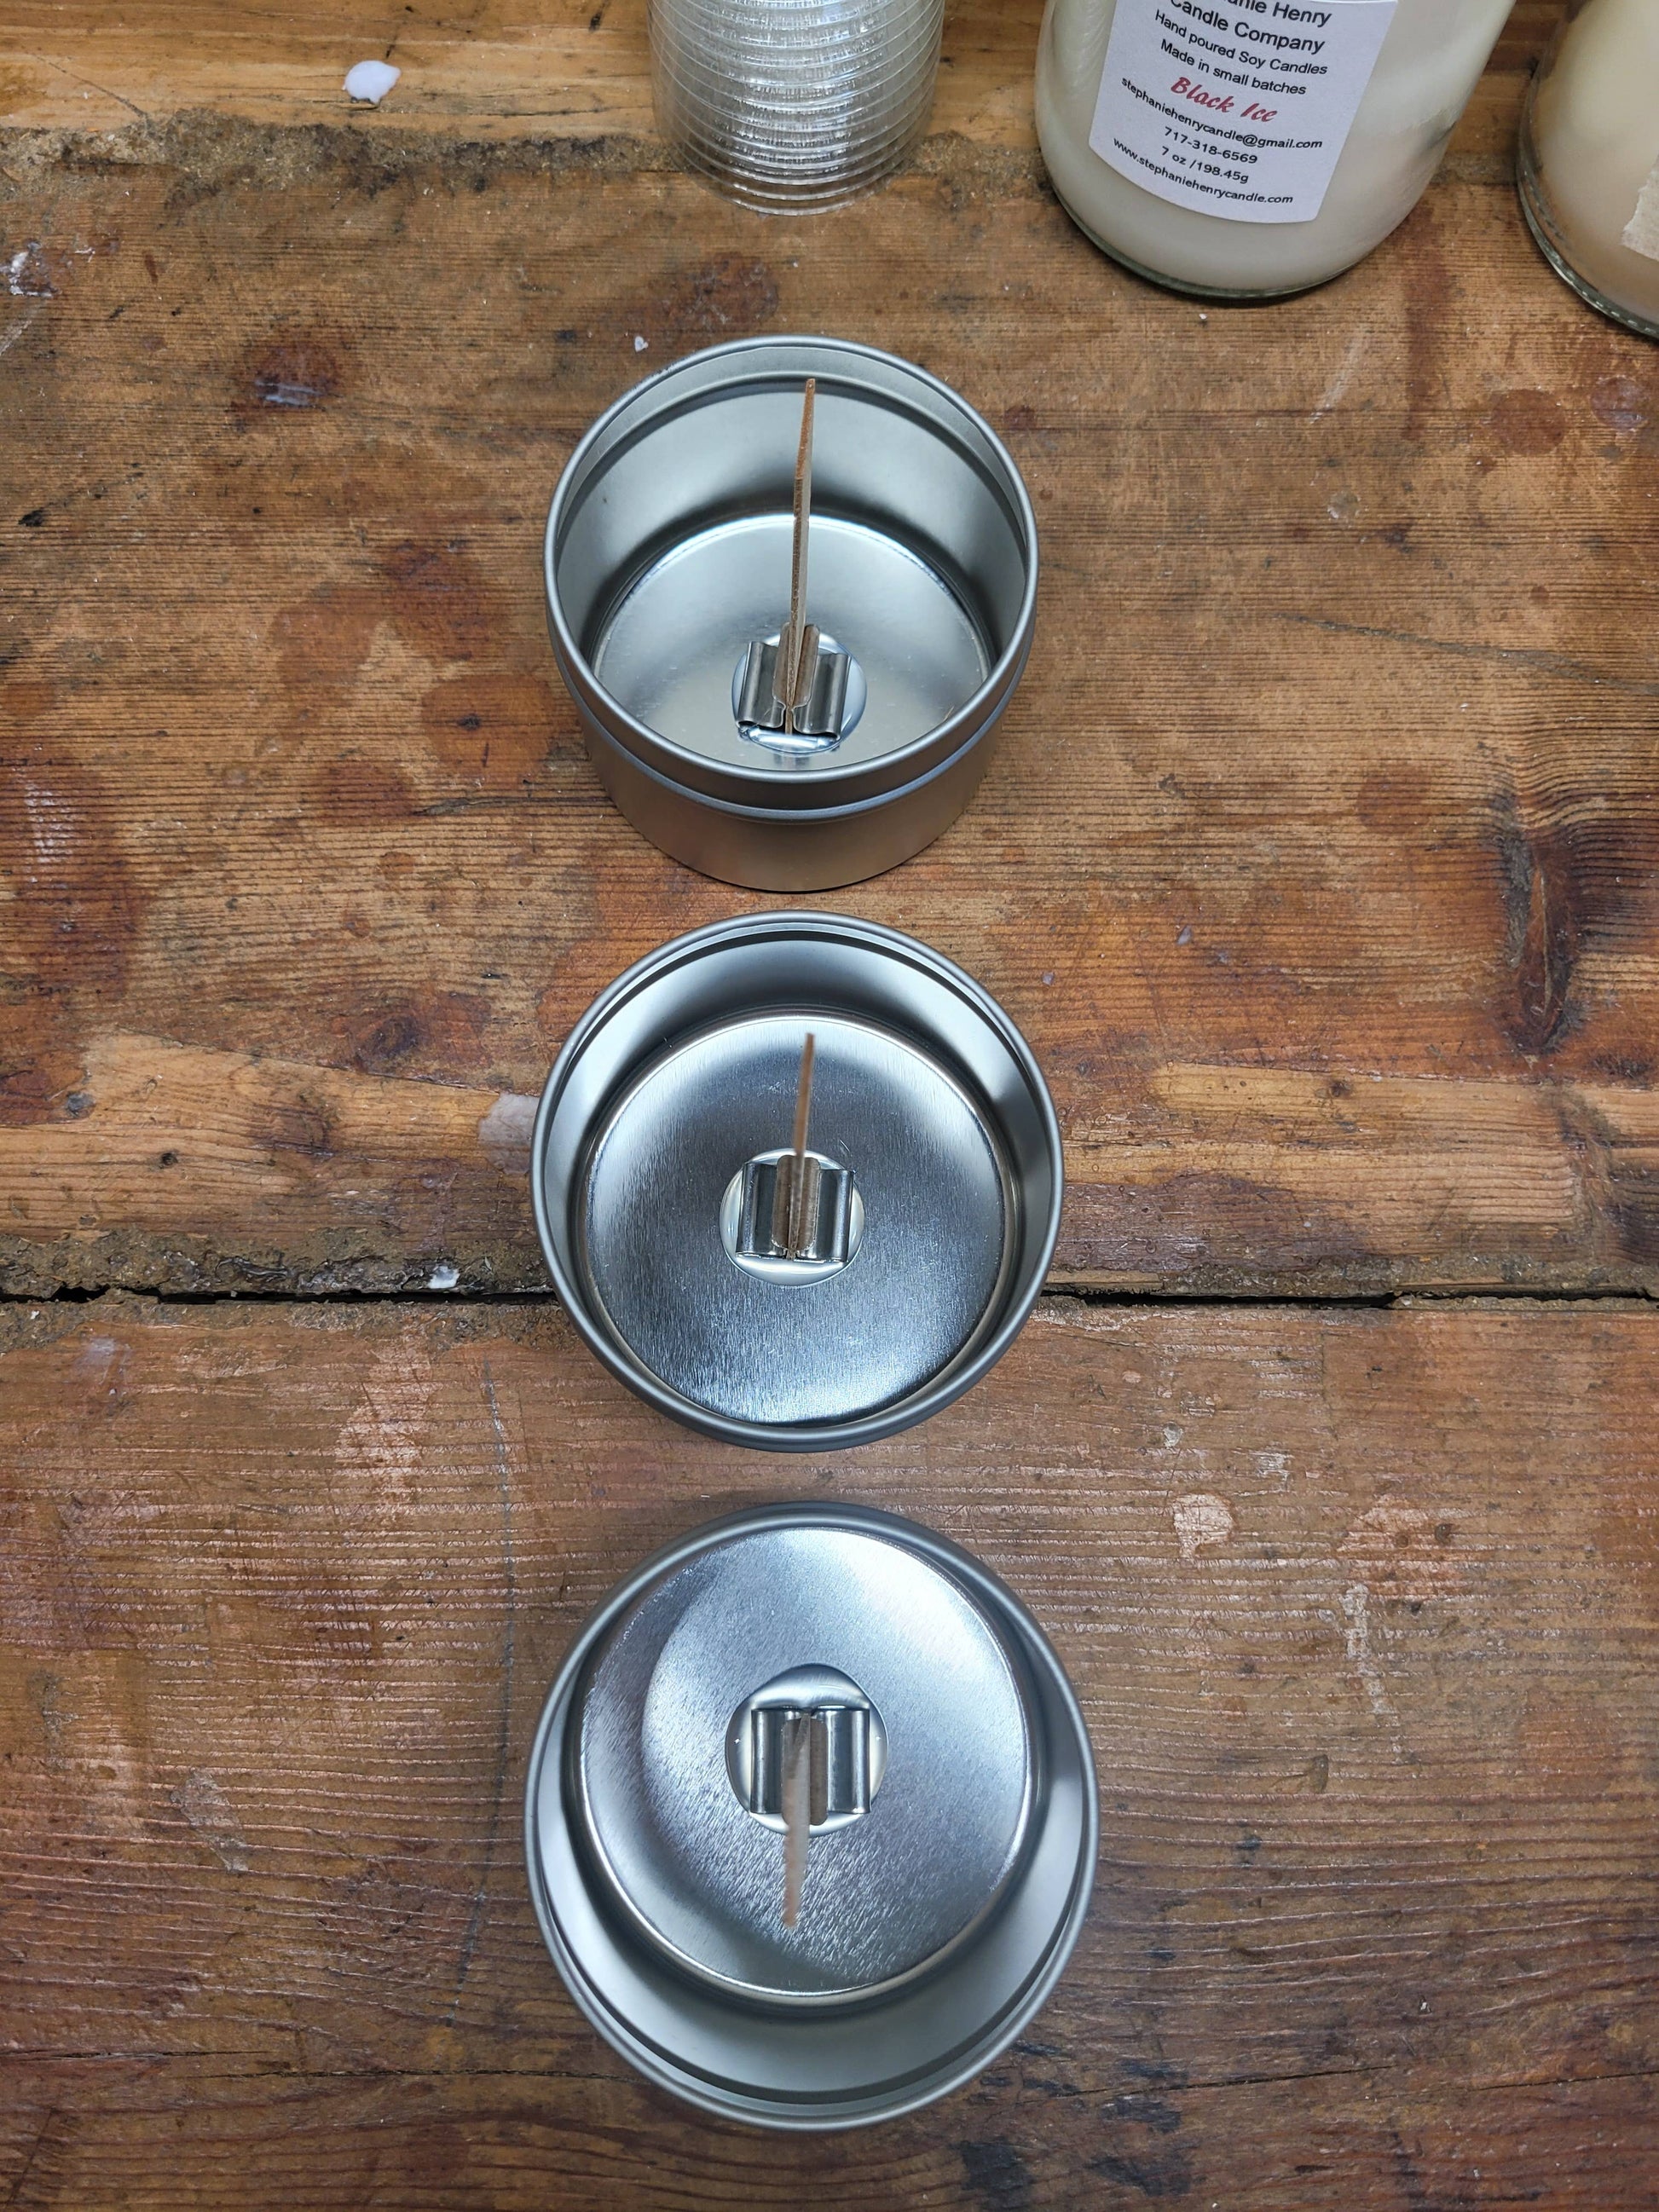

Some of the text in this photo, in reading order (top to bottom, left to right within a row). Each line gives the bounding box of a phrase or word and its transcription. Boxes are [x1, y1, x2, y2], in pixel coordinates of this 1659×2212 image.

[1234, 21, 1326, 55] Company
[1271, 2, 1332, 28] Henry
[1154, 9, 1328, 75] Hand poured Soy Candles
[1160, 38, 1308, 95] Made in small batches
[1121, 77, 1323, 148] stephaniehenrycandle@gmail.com
[1170, 76, 1279, 123] Black Ice
[1161, 146, 1249, 184] 7 oz /198.45g
[1164, 125, 1258, 165] 717-318-6569
[1113, 137, 1294, 204] www.stephaniehenrycandle.com
